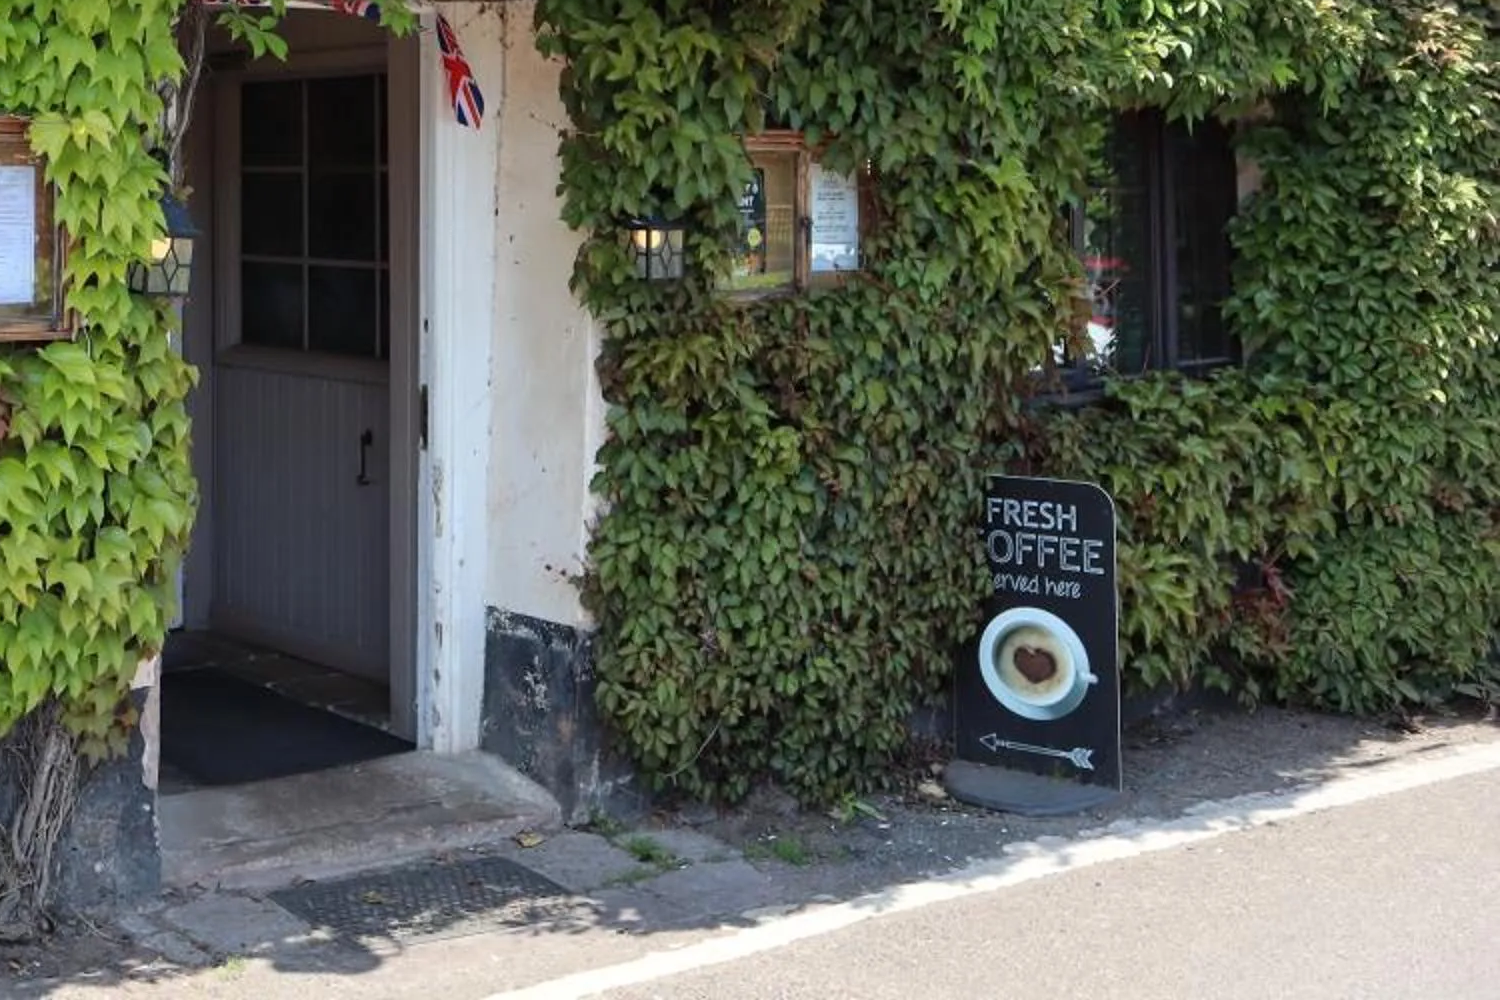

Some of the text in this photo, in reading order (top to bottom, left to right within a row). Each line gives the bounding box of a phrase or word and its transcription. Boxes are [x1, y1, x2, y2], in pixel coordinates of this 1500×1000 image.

[987, 497, 1077, 532] FRESH
[987, 529, 1105, 575] OFFEE
[993, 573, 1081, 599] erved here
